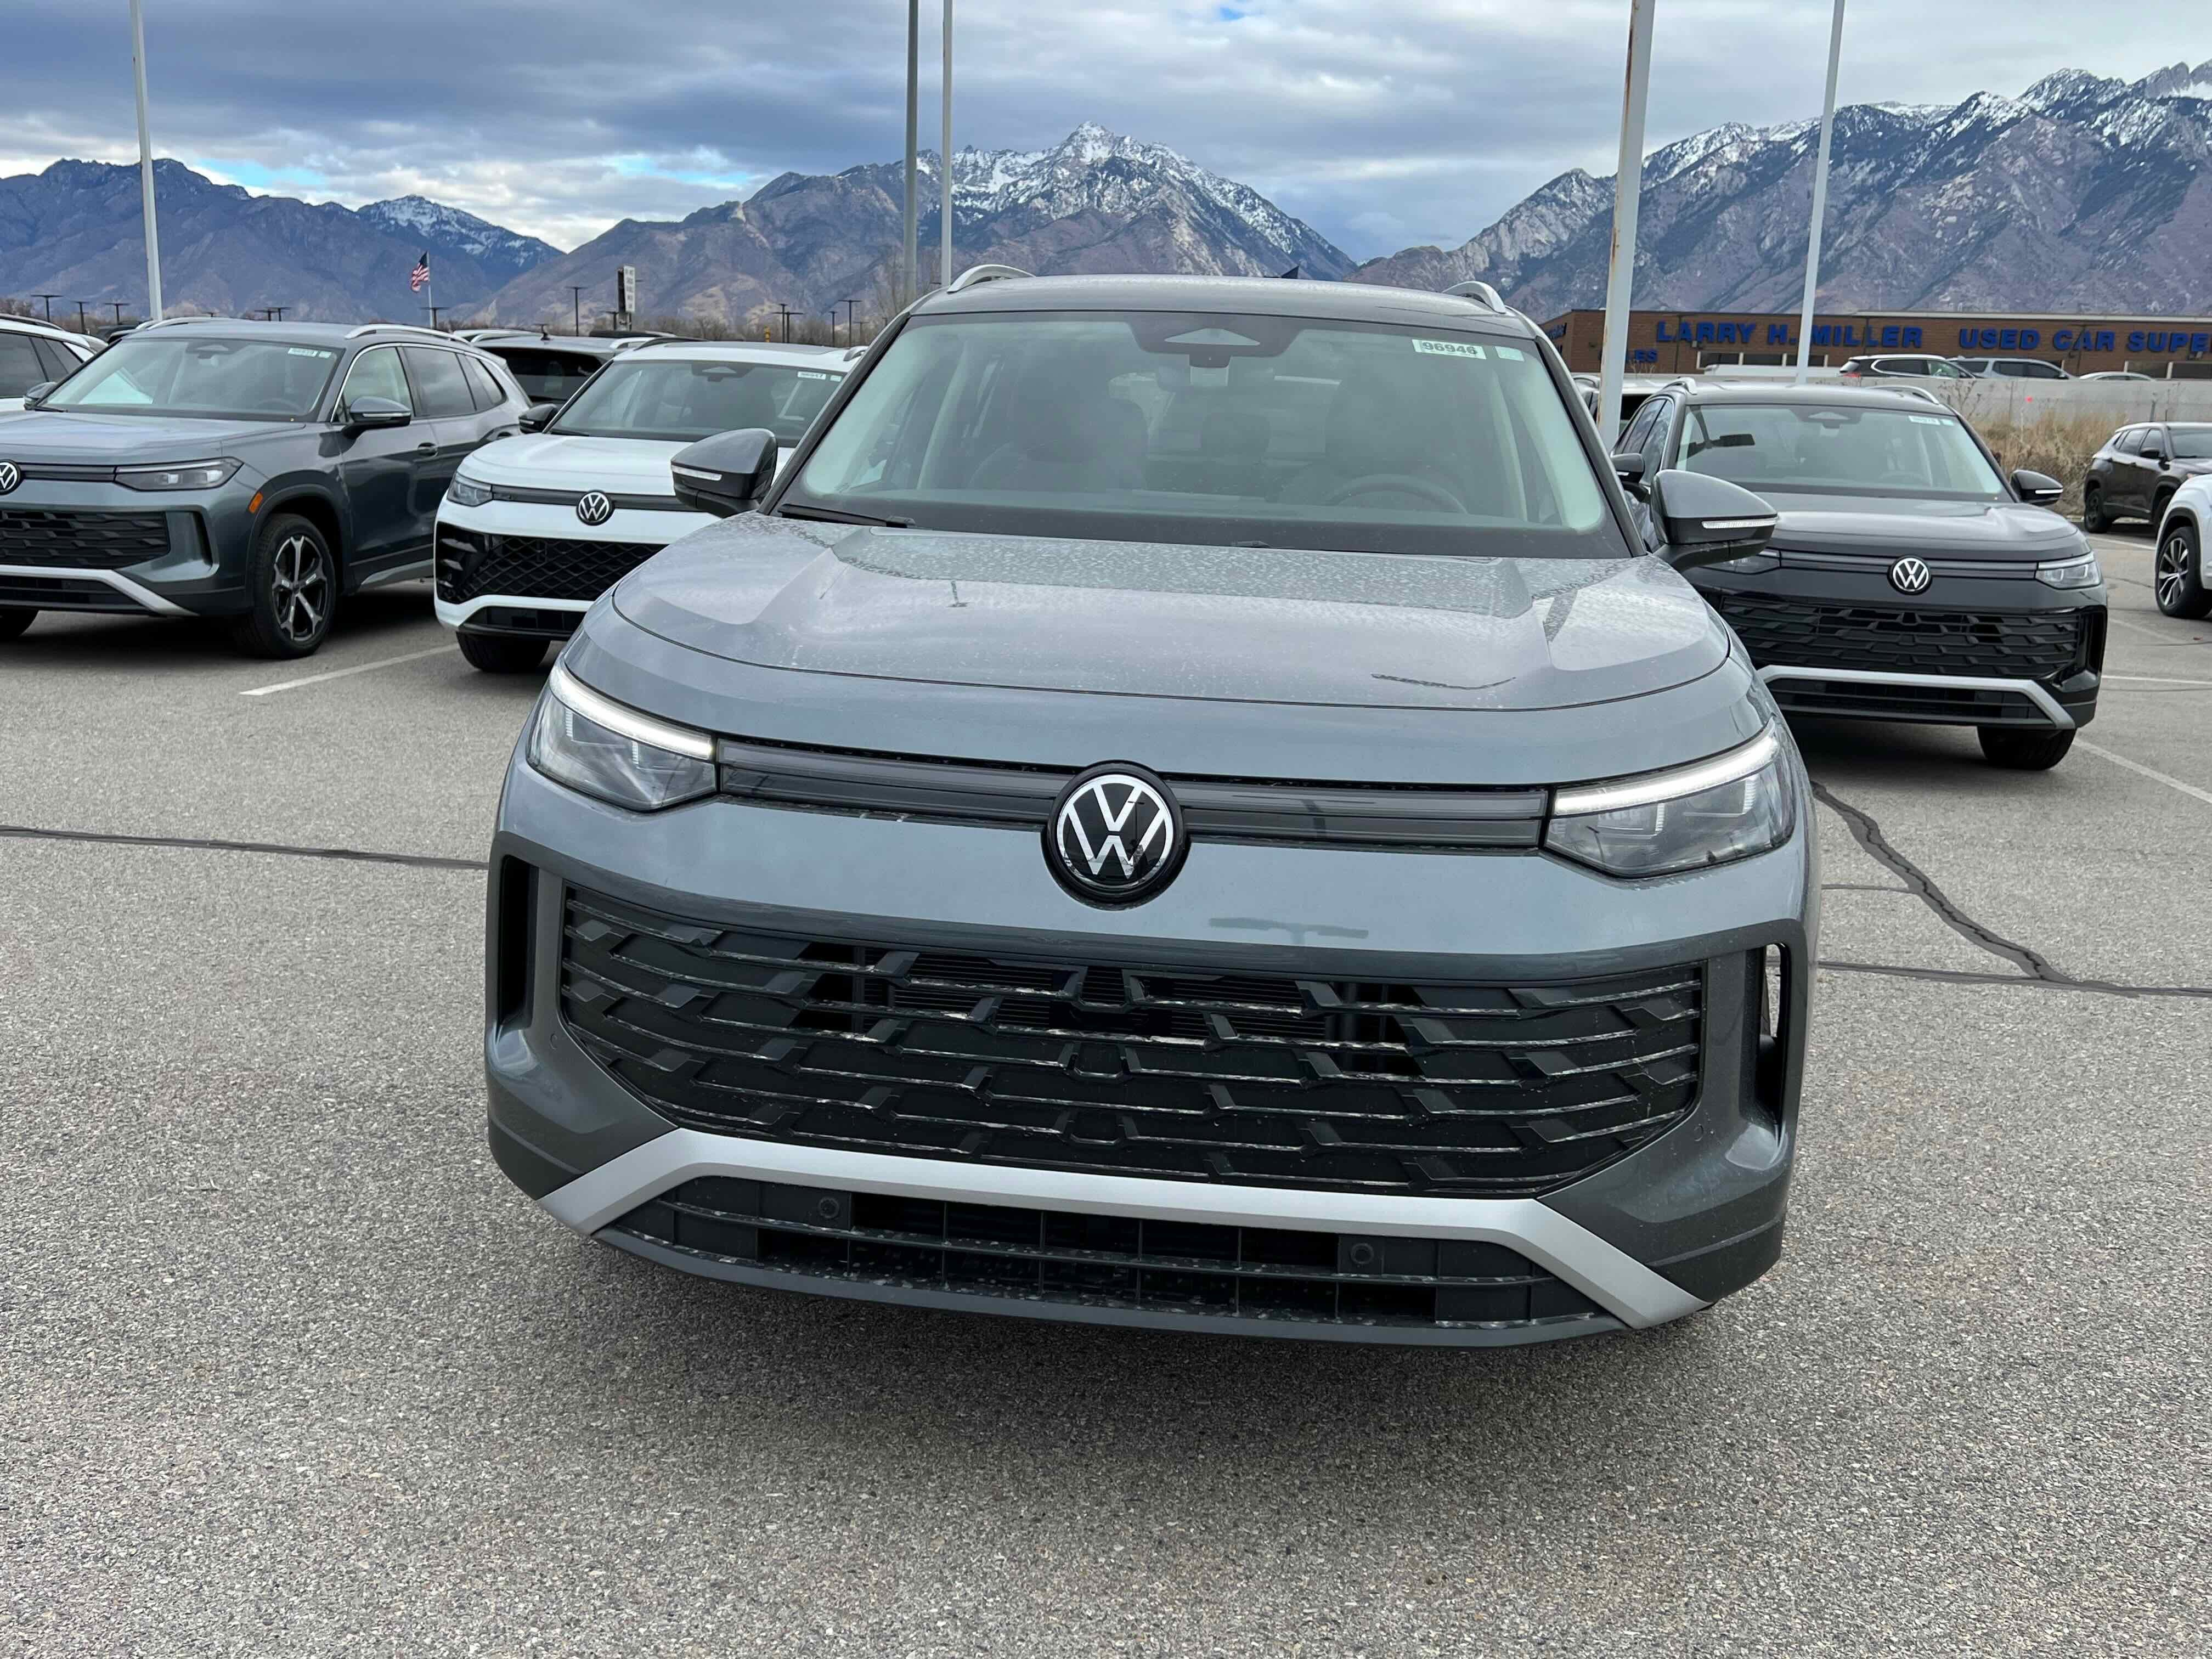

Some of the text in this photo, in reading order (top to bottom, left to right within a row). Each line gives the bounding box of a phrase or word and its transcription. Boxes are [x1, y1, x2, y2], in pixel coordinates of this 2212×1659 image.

[1422, 341, 1478, 355] 96946
[1656, 320, 1756, 343] LARRY
[1767, 324, 1799, 345] H.
[1812, 324, 1923, 348] MILLER
[1959, 328, 2041, 351] USED
[2053, 329, 2116, 352] CAR
[578, 492, 610, 522] VW
[1893, 558, 1929, 591] VW
[1057, 774, 1173, 884] VW
